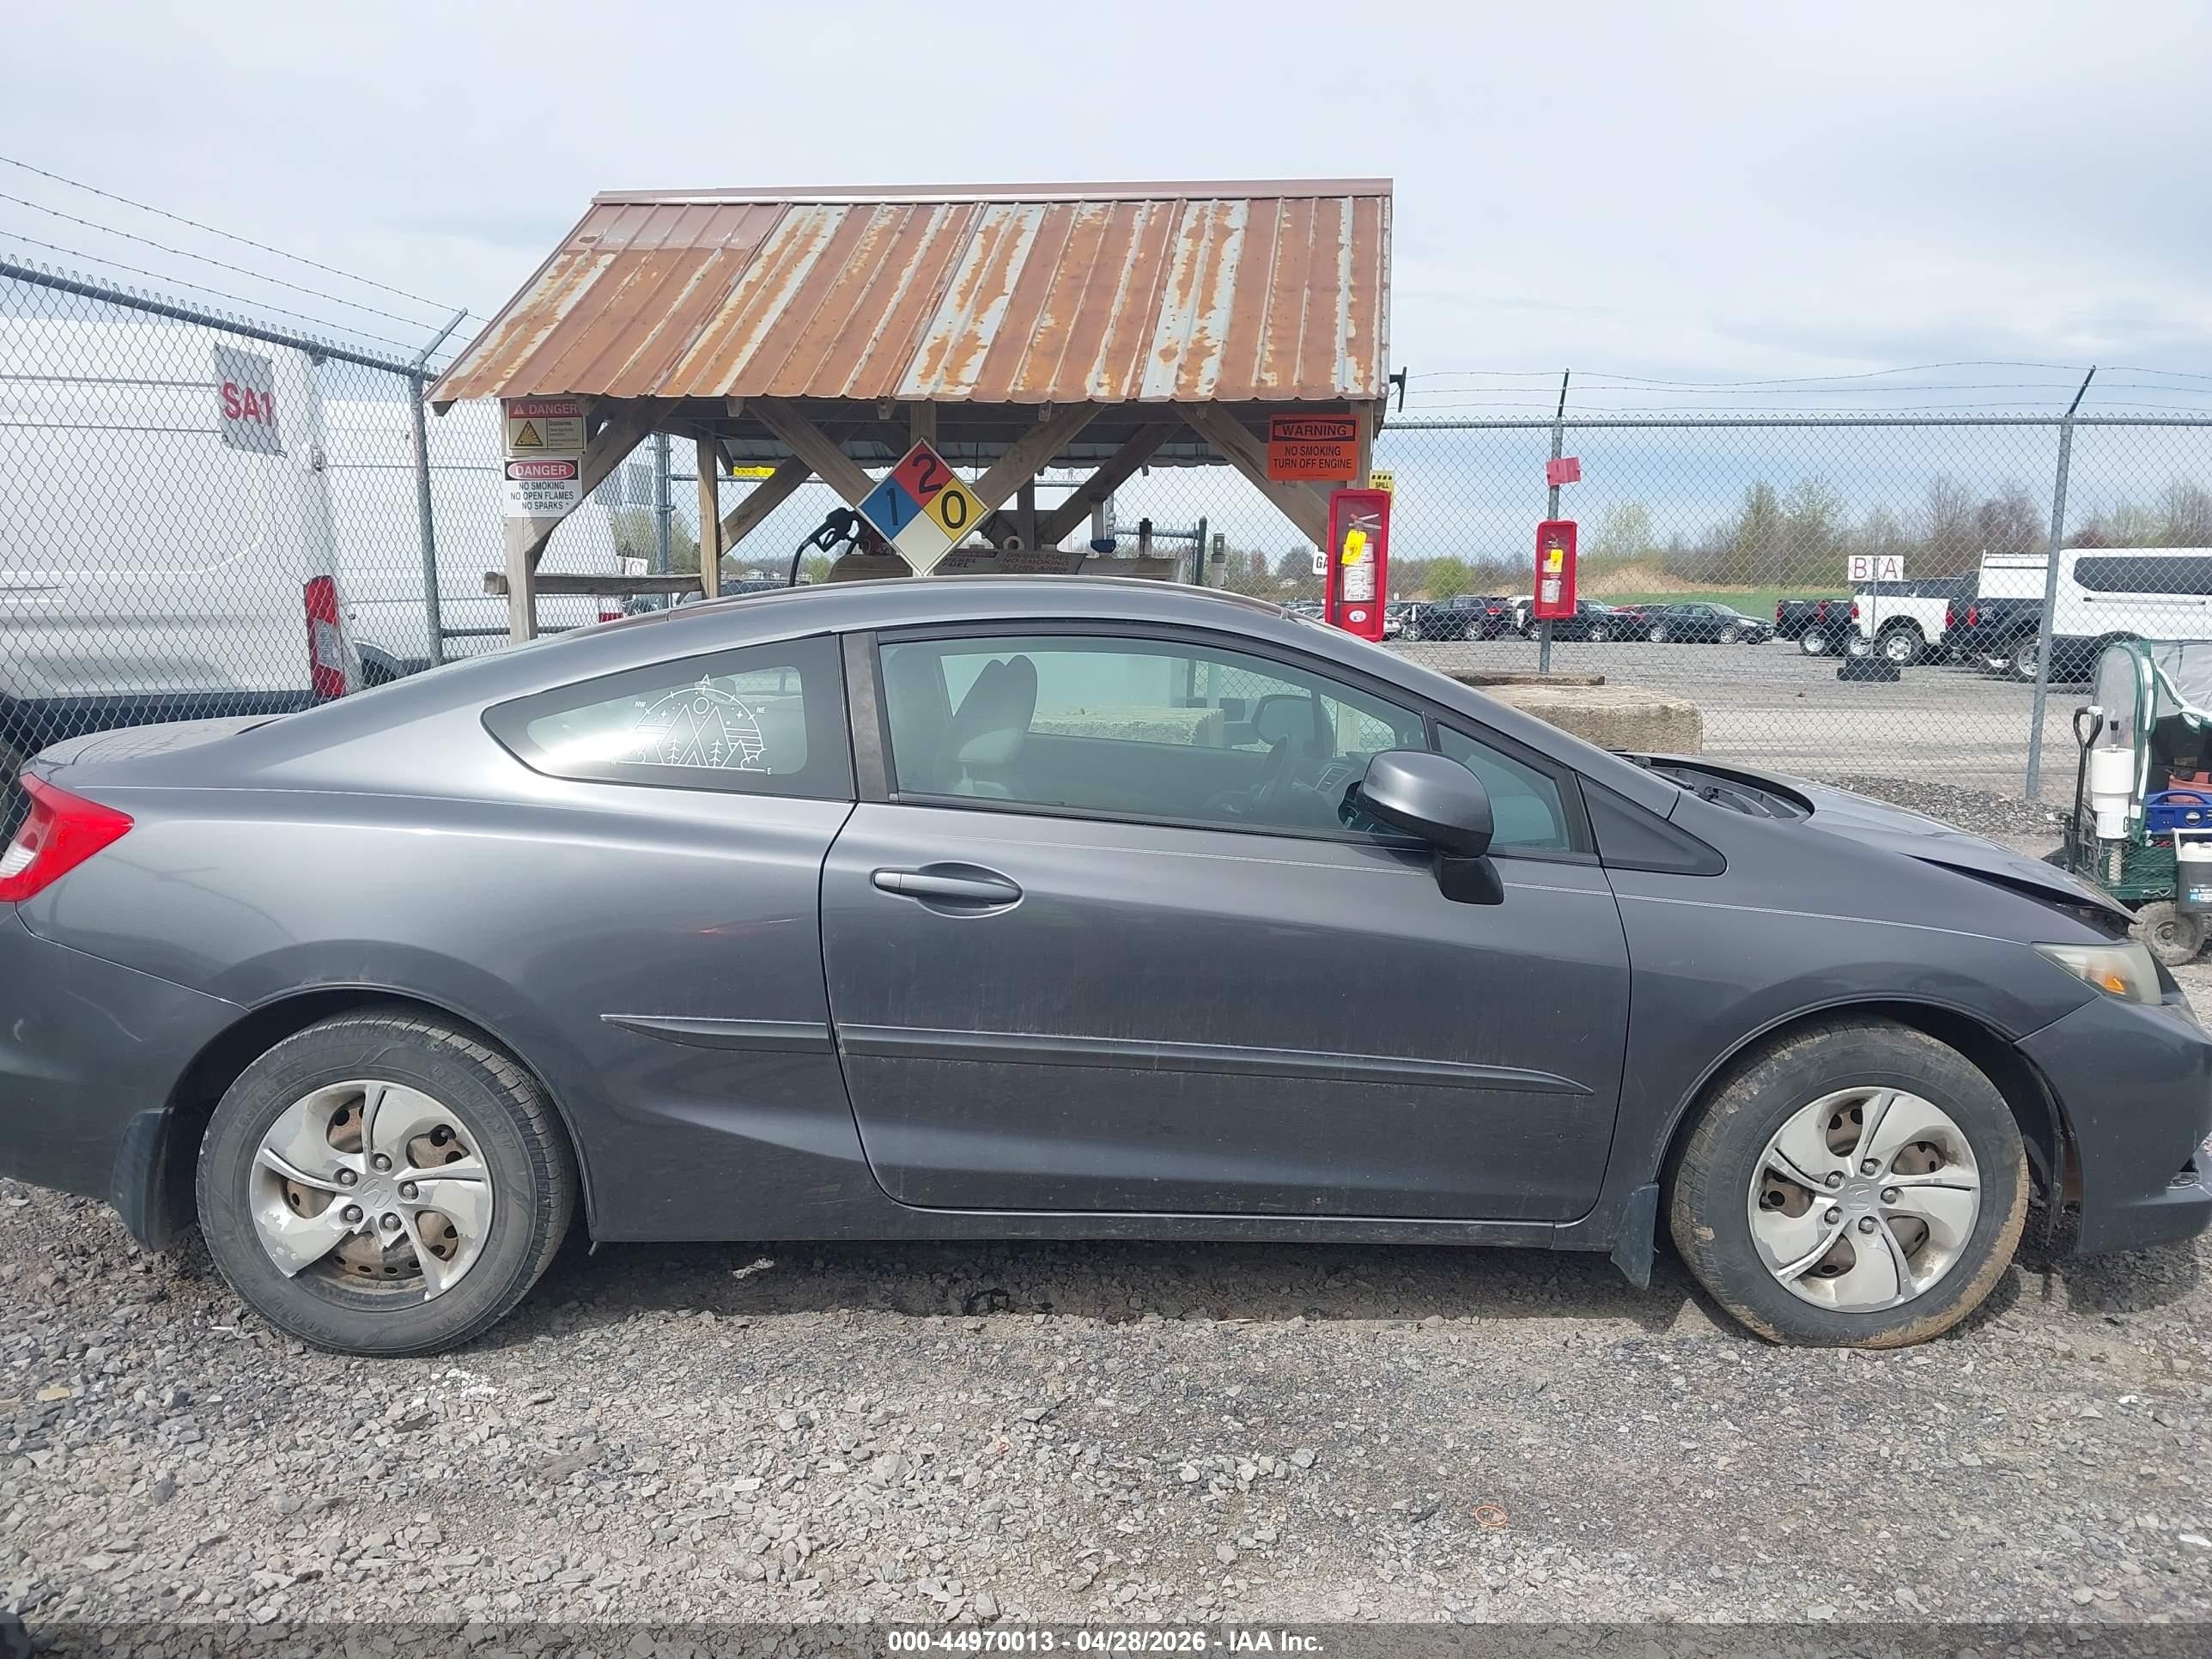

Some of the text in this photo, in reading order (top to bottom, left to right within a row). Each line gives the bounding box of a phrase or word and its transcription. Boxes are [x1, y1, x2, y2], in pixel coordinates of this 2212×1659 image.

[222, 382, 272, 427] SA1
[528, 404, 578, 415] DANGER
[1282, 425, 1347, 436] WARNING
[1285, 446, 1340, 456] NO SMOKING
[1273, 459, 1352, 469] TURN OFF ENGINE
[515, 465, 567, 476] DANGER
[912, 453, 943, 495] 2
[519, 481, 565, 490] NO SMOKING
[510, 490, 574, 501] NO OPEN FLAMES
[521, 501, 563, 510] NO SPARKS
[885, 487, 899, 526] 1
[940, 489, 967, 529] 0
